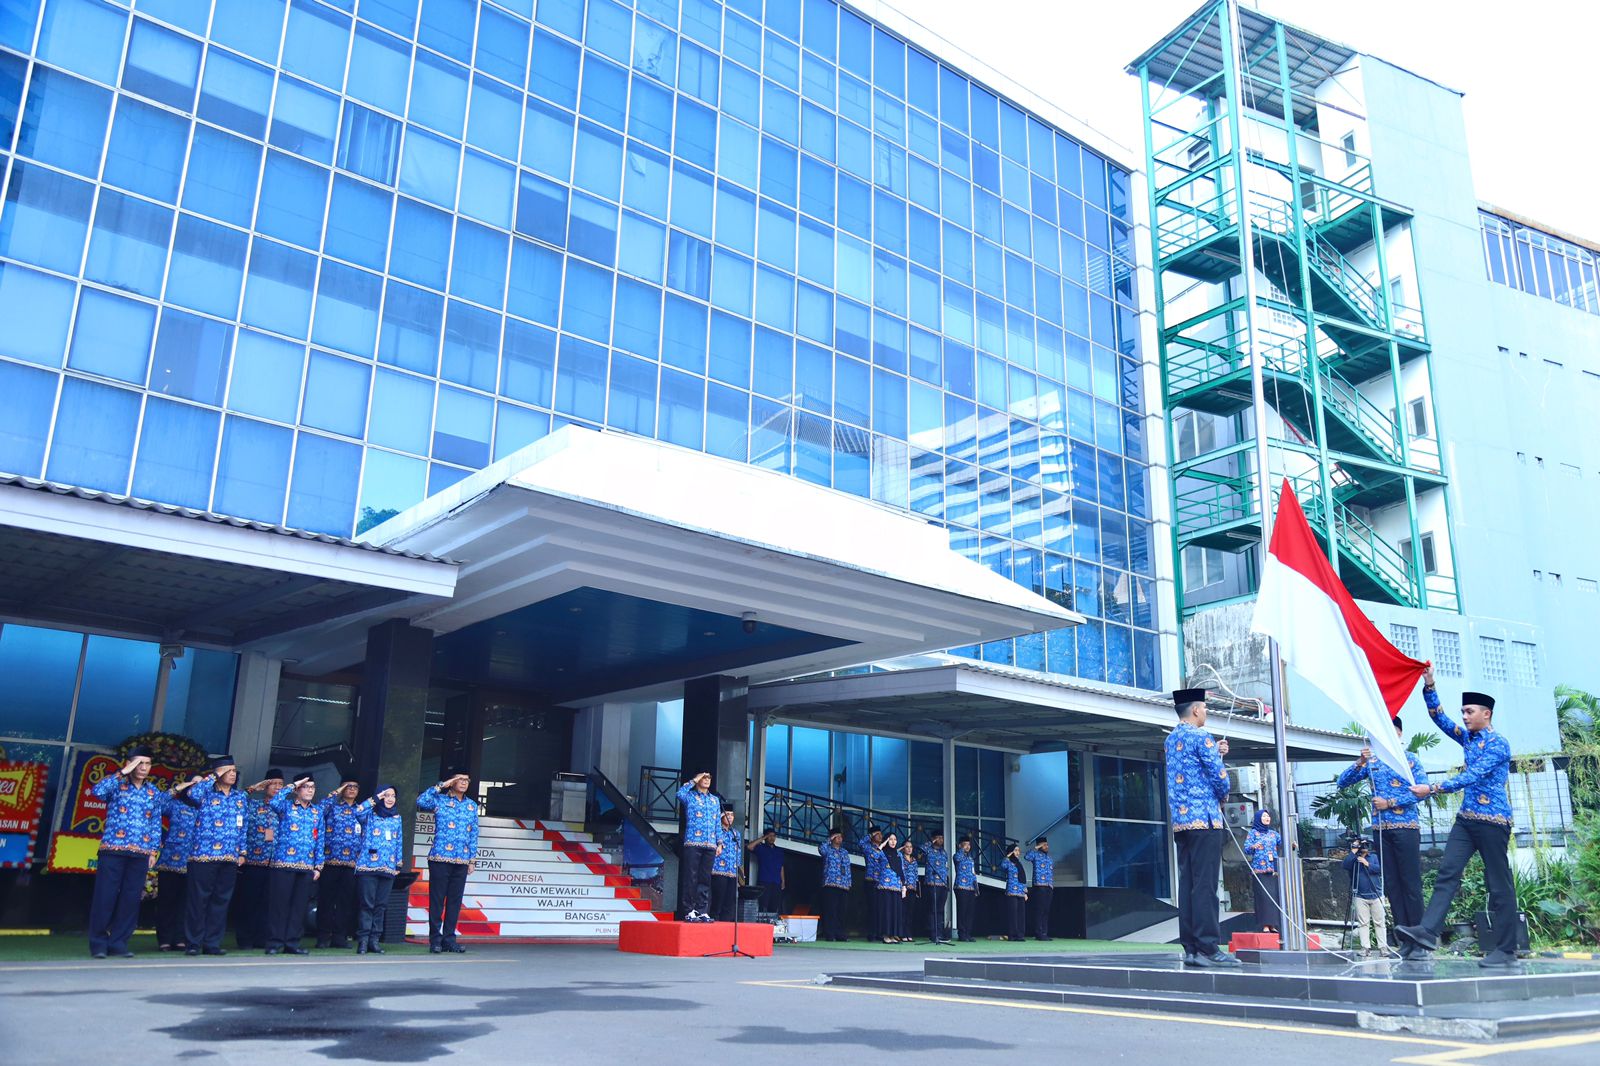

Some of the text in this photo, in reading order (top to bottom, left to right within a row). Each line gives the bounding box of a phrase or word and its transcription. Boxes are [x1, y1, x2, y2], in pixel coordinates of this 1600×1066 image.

[488, 873, 544, 882] INDONESIA
[510, 886, 590, 896] YANG MEWAKILI
[537, 900, 573, 908] WAJAH
